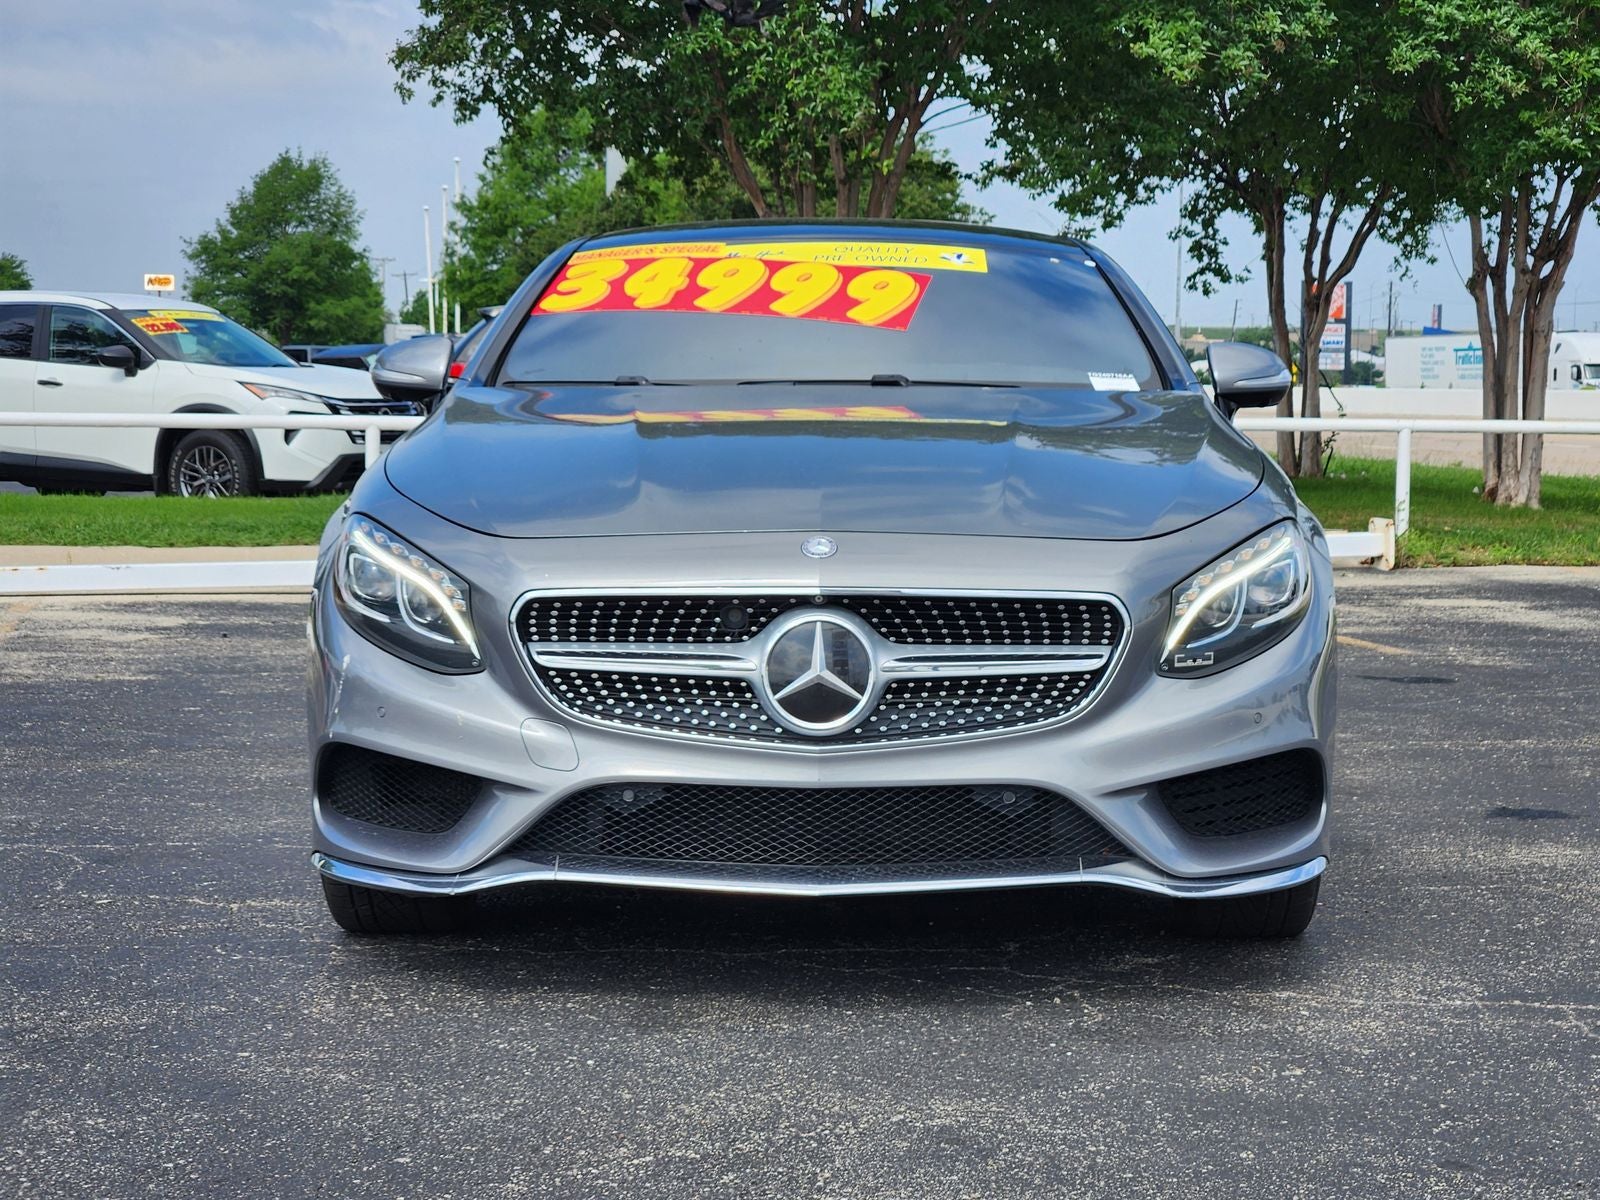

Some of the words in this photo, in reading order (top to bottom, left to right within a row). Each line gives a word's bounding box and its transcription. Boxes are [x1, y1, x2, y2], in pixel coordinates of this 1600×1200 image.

[575, 247, 656, 260] MANAGER'S
[660, 245, 720, 254] SPECIAL
[835, 246, 914, 254] QUALITY
[539, 257, 920, 326] 34999
